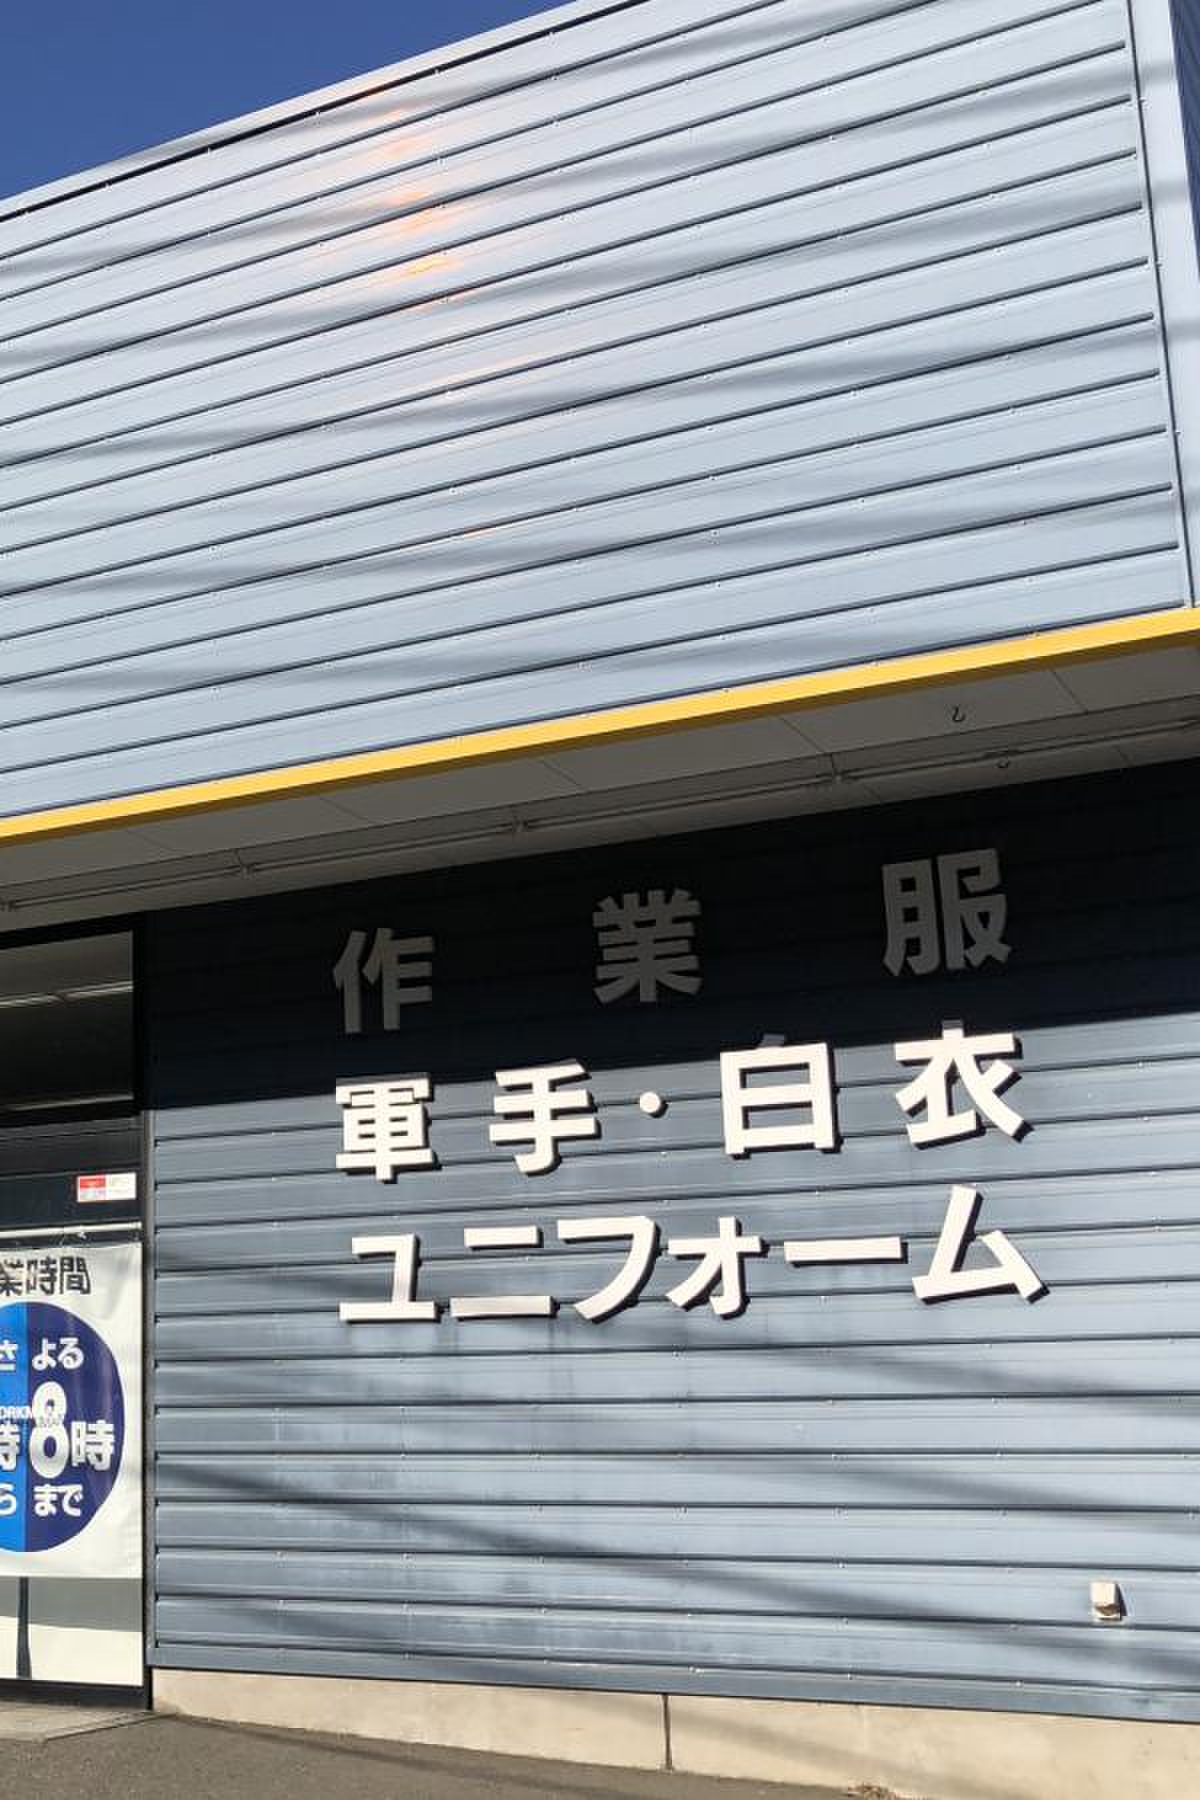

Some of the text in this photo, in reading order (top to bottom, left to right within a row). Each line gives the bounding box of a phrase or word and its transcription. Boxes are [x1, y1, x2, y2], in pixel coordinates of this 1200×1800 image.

[332, 847, 1013, 1035] 作業服
[338, 1184, 1048, 1324] ユニフォーム
[31, 1337, 85, 1371] よる
[33, 1482, 84, 1518] まで
